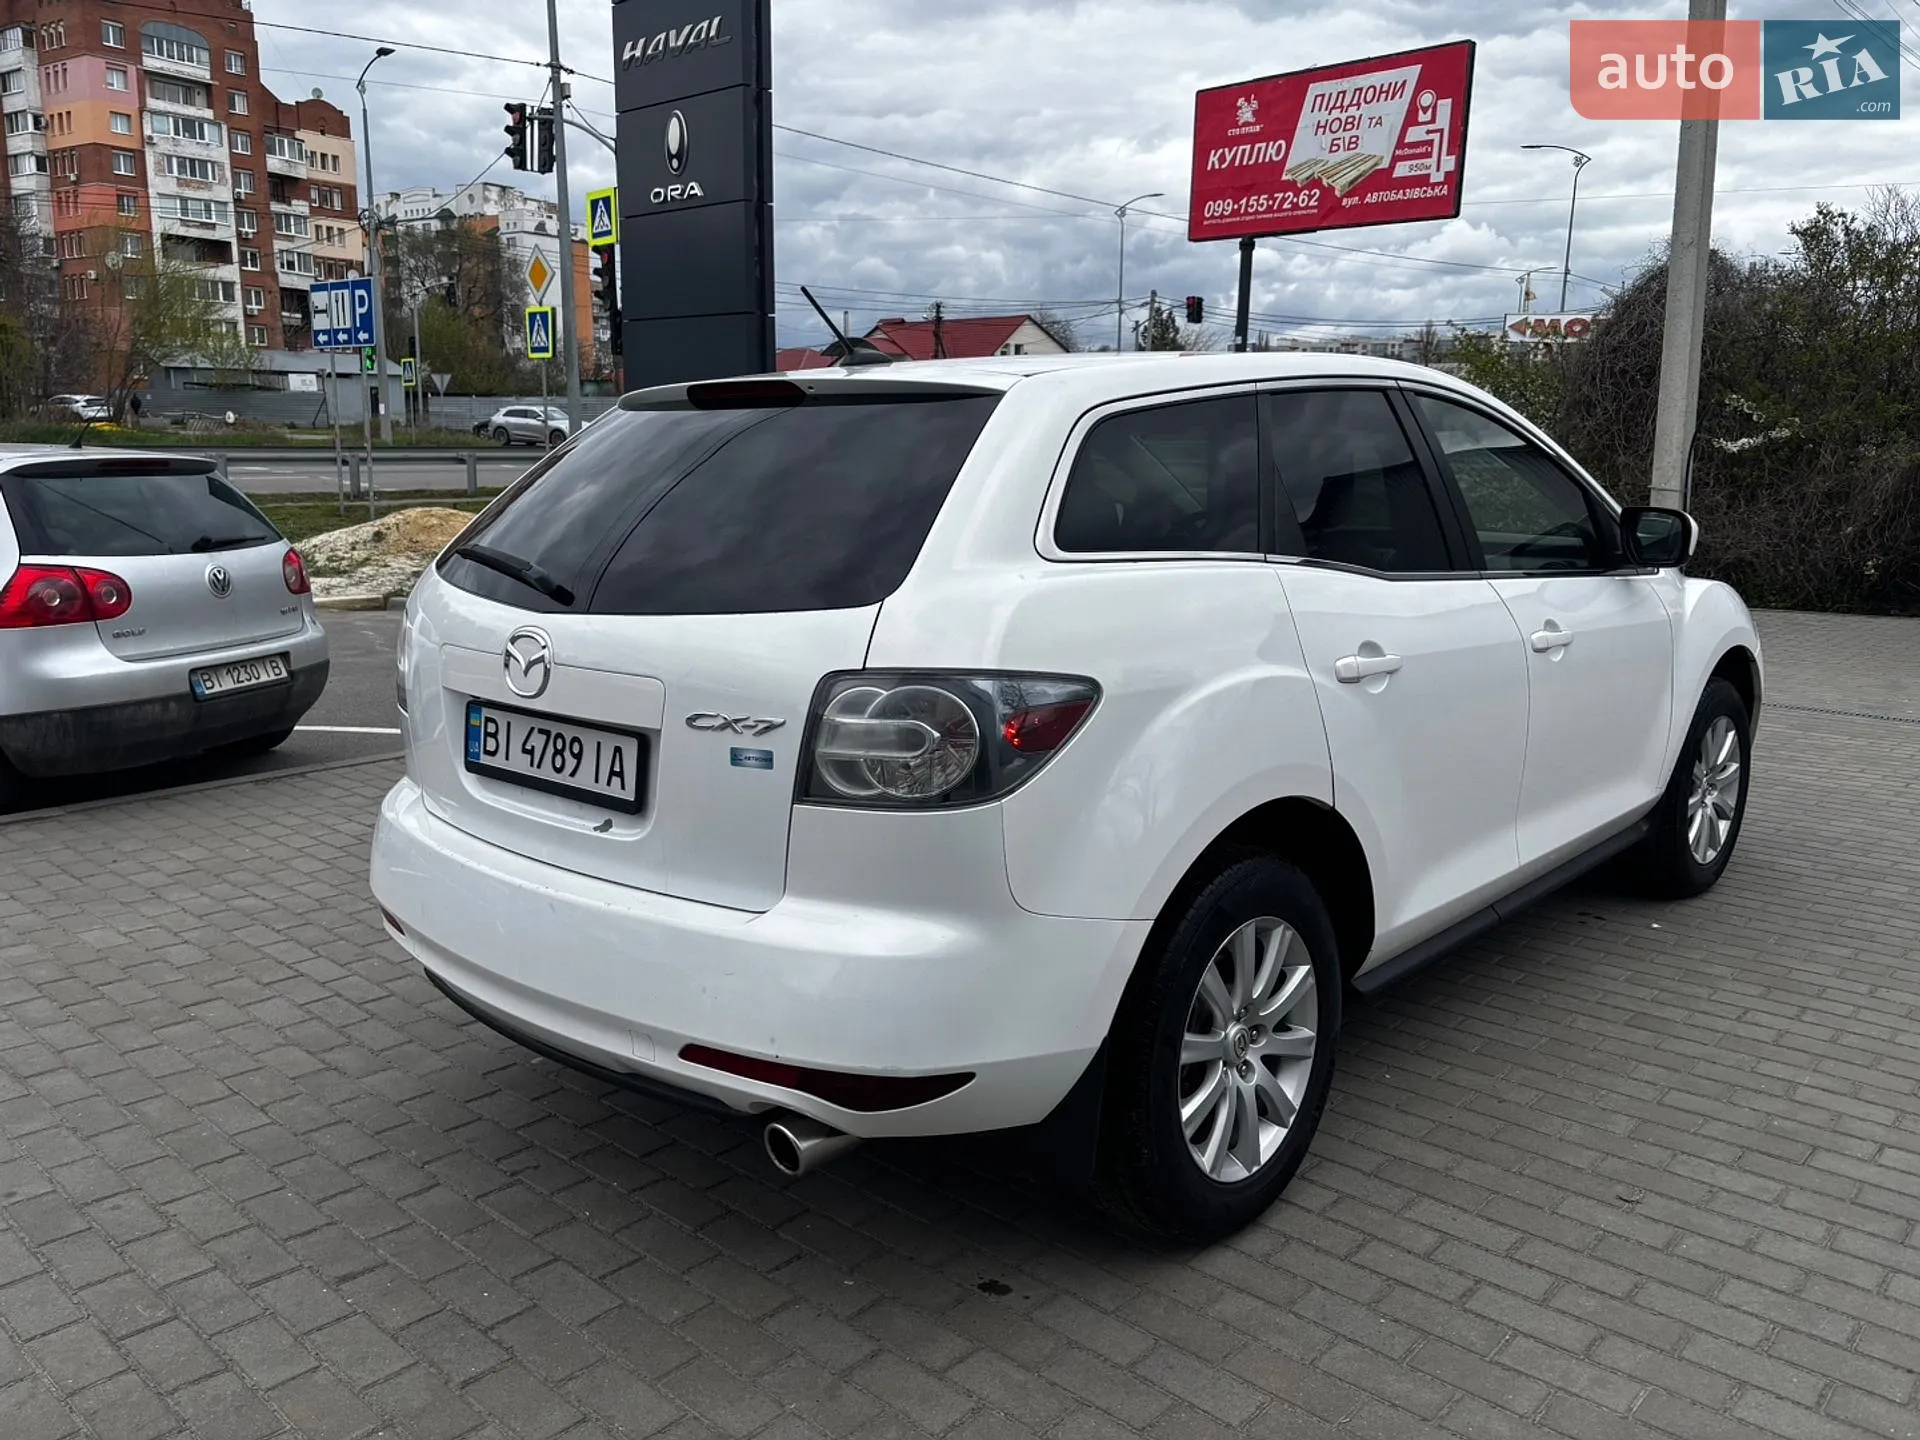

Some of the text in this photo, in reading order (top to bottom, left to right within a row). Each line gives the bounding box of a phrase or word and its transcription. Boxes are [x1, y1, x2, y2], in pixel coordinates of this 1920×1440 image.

[622, 15, 734, 70] HAVAL
[1310, 79, 1408, 116] ПІДДОНИ
[1314, 114, 1384, 136] НОВІ ТА
[1206, 139, 1287, 171] КУПЛЮ
[650, 181, 705, 204] ORA
[1364, 184, 1449, 204] АВТОБАЗІВСЬКА
[354, 288, 369, 328] P
[200, 659, 283, 691] BI 1230 IB
[685, 711, 787, 737] CX-7
[483, 715, 626, 791] BI 4789 IA
